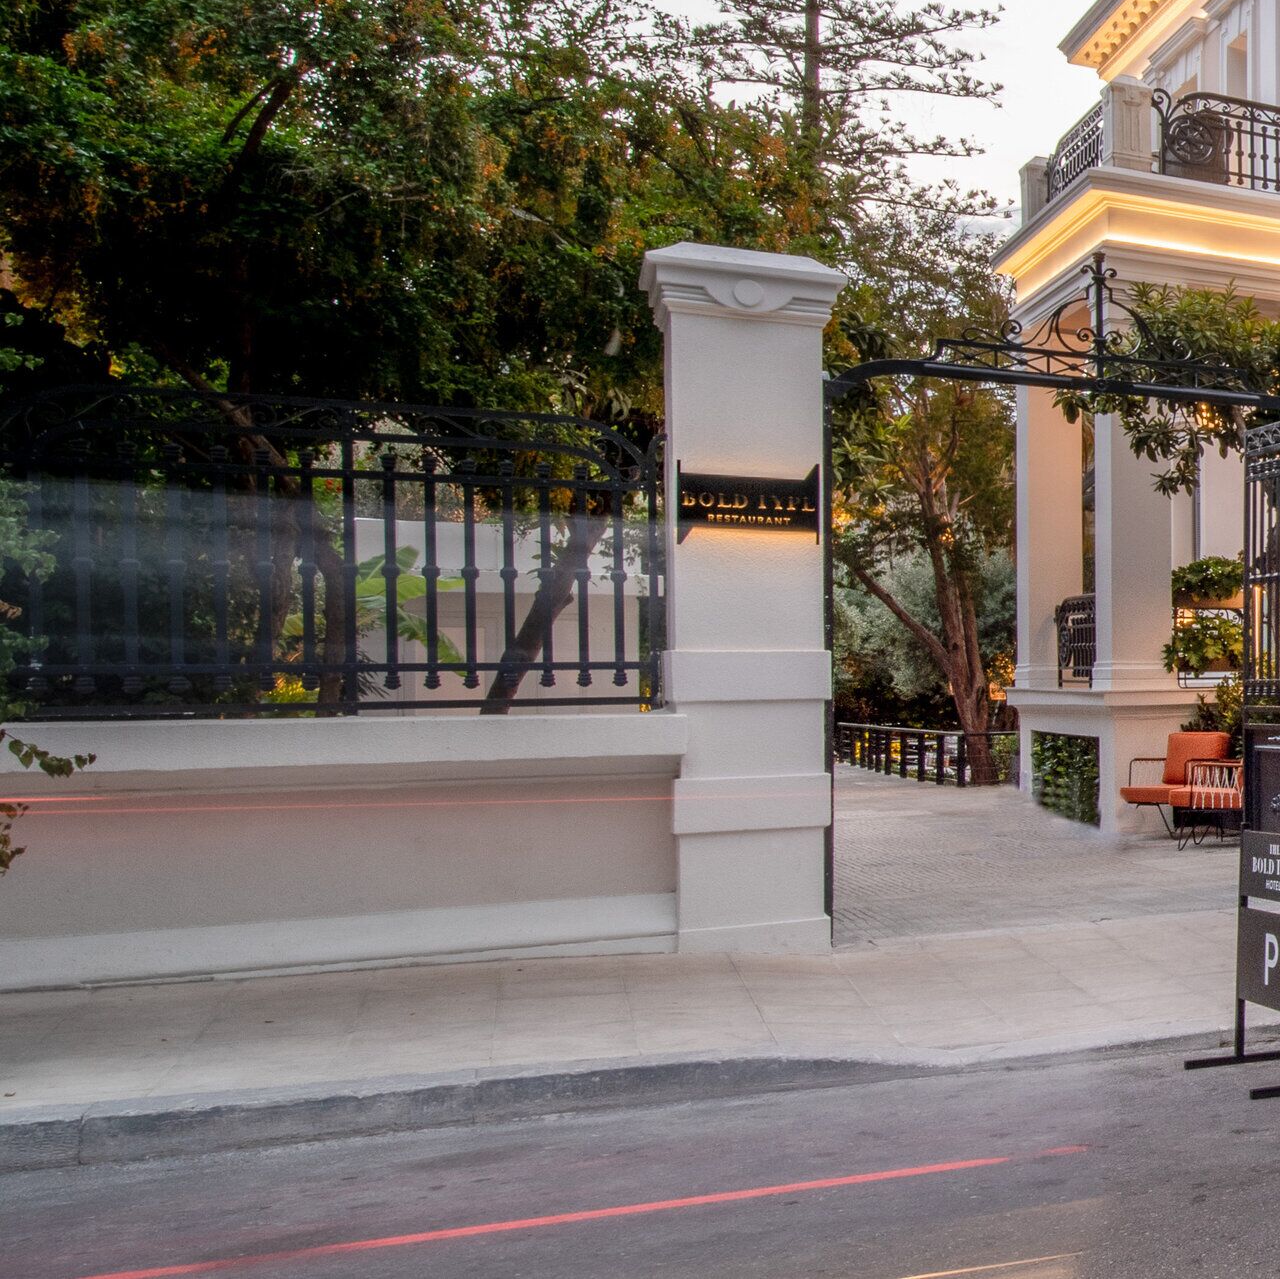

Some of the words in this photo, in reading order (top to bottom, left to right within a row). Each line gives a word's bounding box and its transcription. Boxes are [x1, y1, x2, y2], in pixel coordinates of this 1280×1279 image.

[682, 491, 749, 508] BOLD
[707, 513, 791, 525] RESTAURANT
[1252, 856, 1275, 875] BOLD
[1265, 879, 1280, 891] HOTEL
[1264, 933, 1279, 985] P
